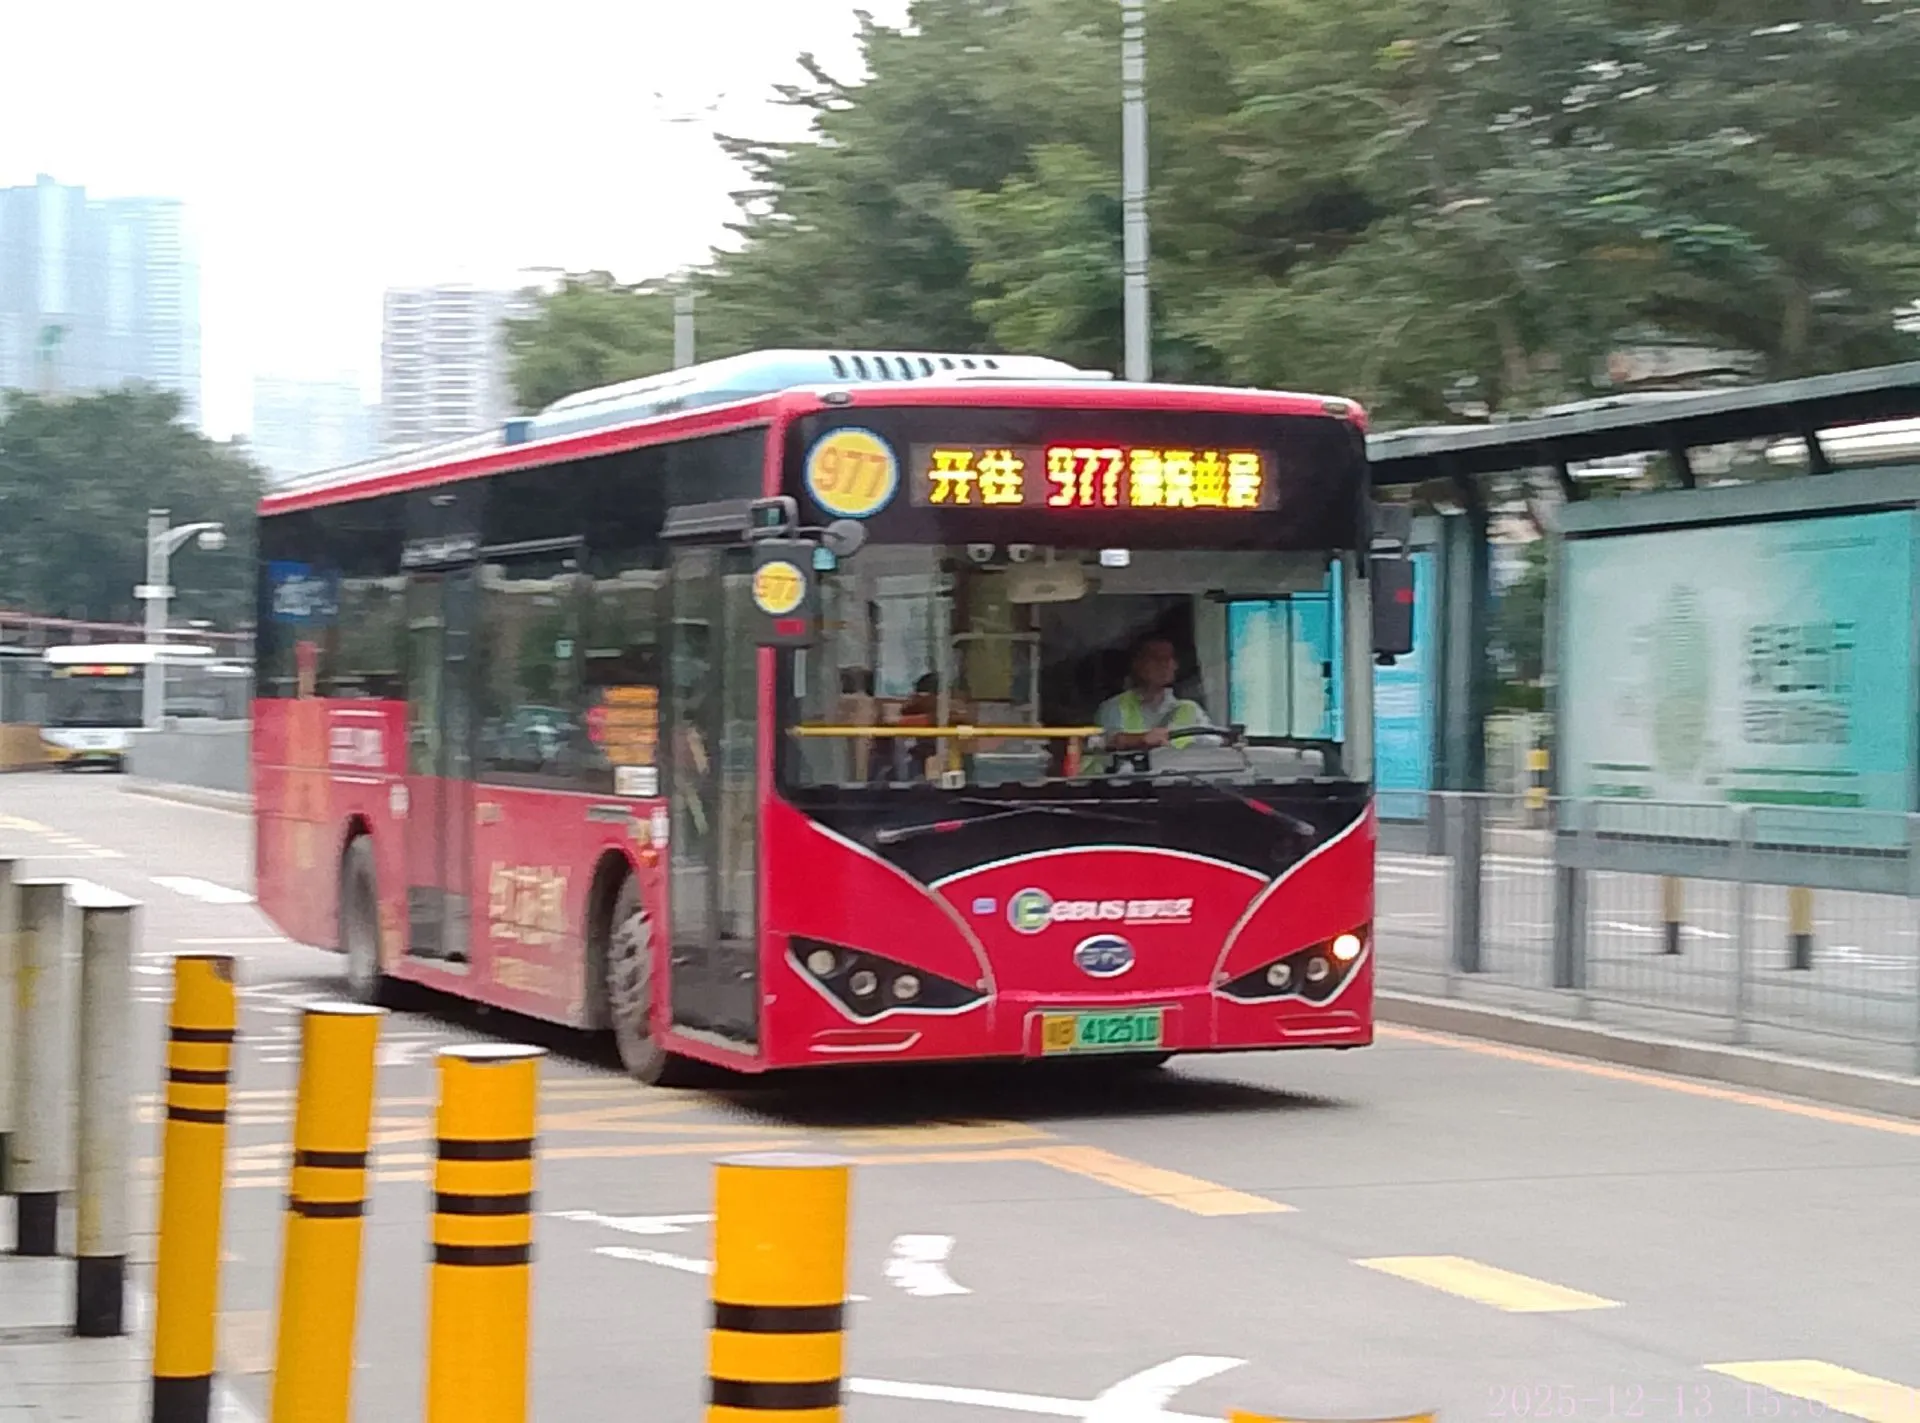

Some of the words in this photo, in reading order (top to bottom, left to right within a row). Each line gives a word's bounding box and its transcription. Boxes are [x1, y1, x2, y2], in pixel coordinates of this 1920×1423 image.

[813, 446, 888, 498] 977
[928, 448, 1024, 504] 开往
[1047, 446, 1125, 507] 977
